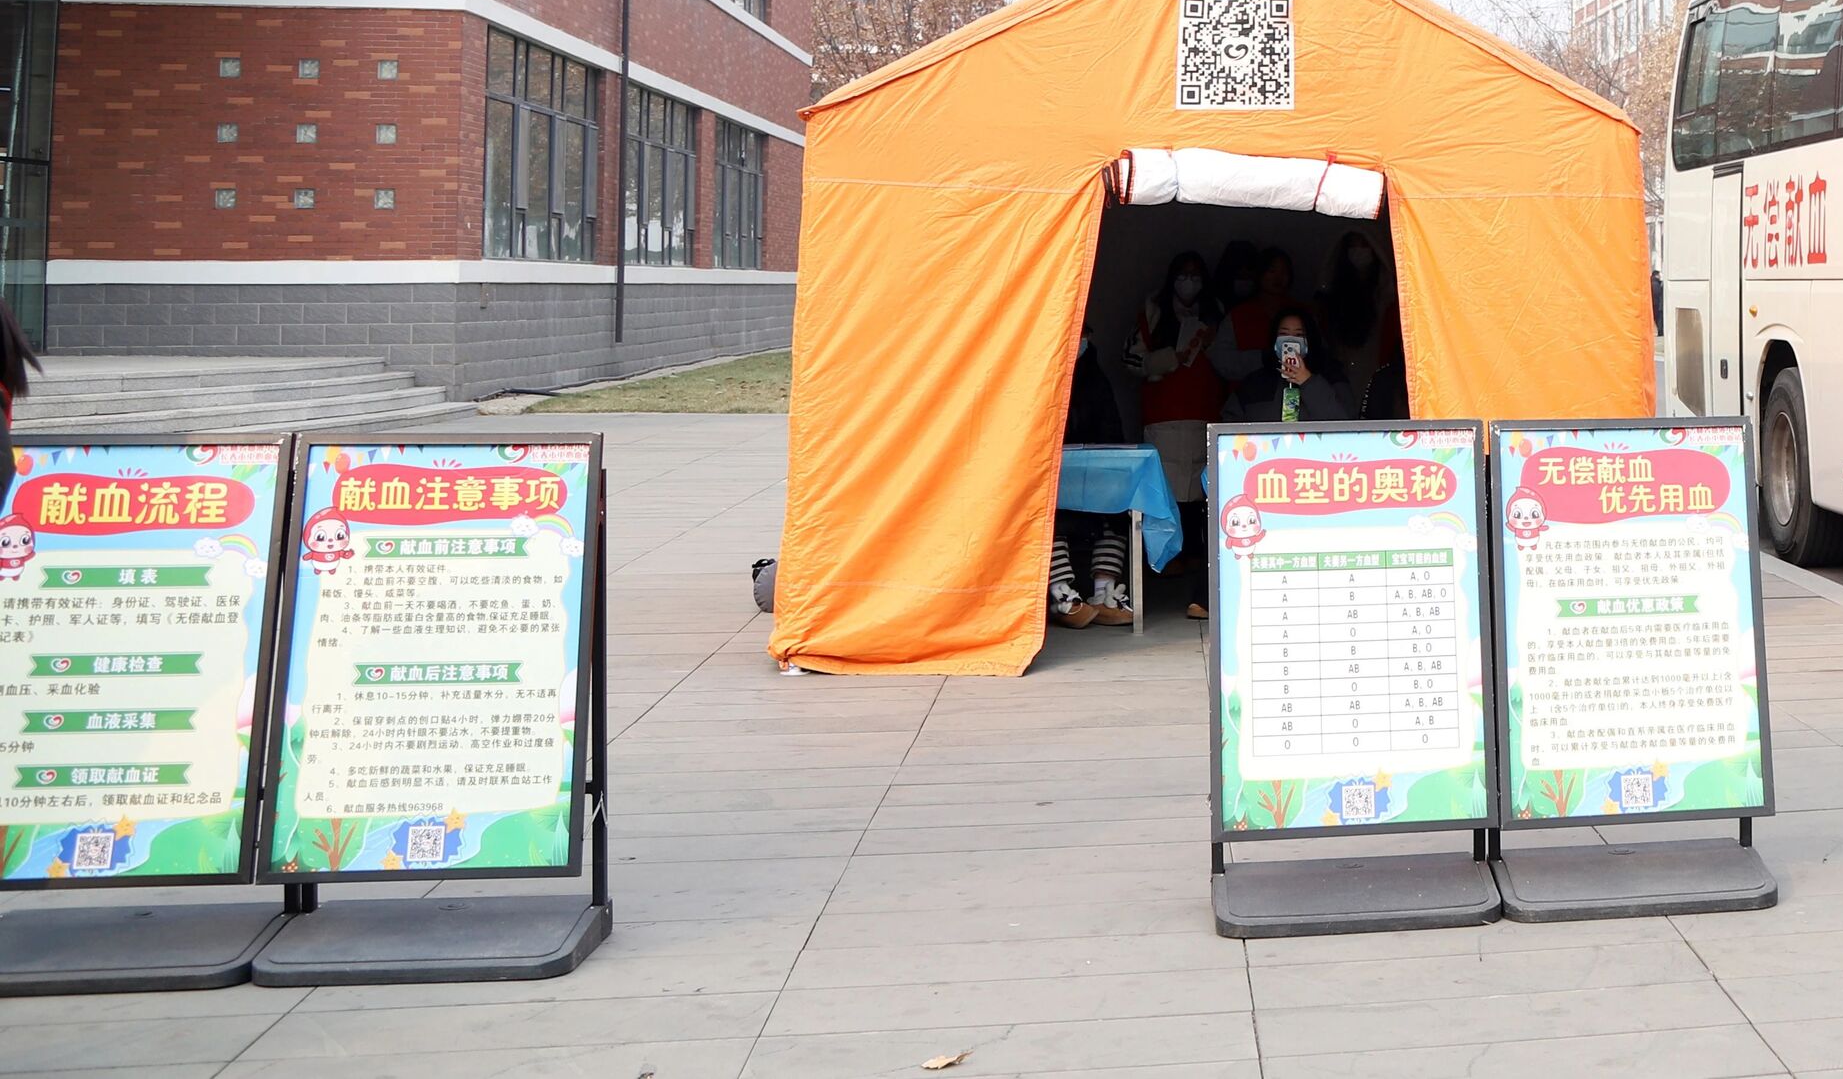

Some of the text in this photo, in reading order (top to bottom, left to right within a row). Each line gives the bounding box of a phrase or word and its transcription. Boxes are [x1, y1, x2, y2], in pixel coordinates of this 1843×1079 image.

[1744, 171, 1827, 269] 无偿献血
[1538, 455, 1655, 485] 无偿献血
[339, 476, 560, 511] 献血注意事项
[1254, 465, 1446, 504] 血型的奥秘
[40, 482, 228, 525] 献血流程
[1599, 483, 1715, 514] 优先用血
[399, 538, 516, 555] 献血前注意事项
[118, 568, 157, 585] 填表
[1596, 598, 1684, 614] 献血优惠政策
[93, 656, 163, 674] 健康检查
[390, 664, 508, 681] 献血后注意事项
[86, 712, 156, 730] 血液采集
[71, 767, 159, 785] 领取献血证
[0, 792, 222, 808] 10分钟左右后，领取献血证和纪念品
